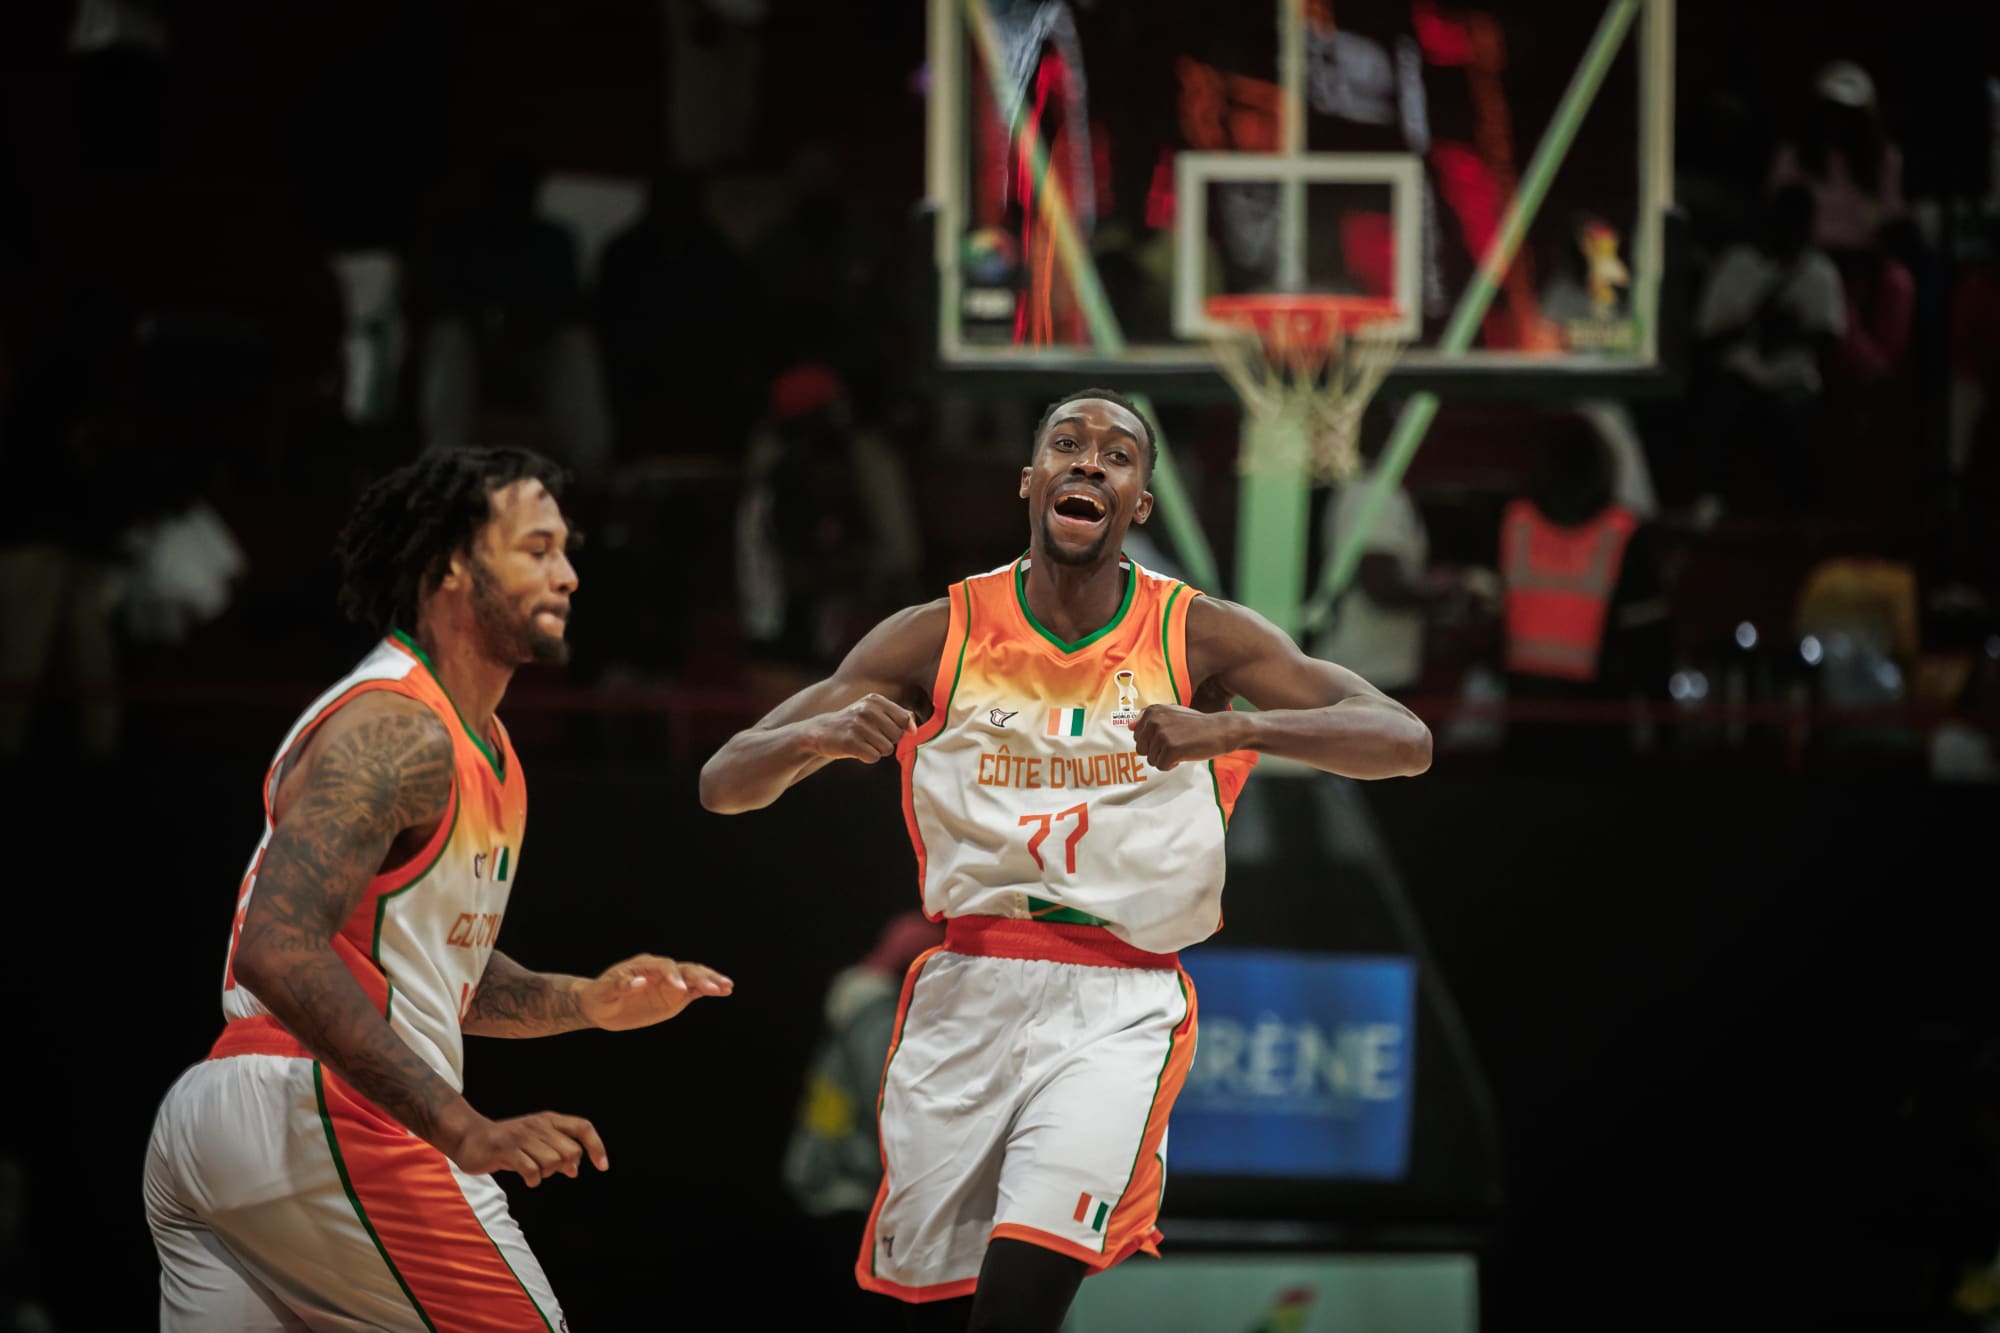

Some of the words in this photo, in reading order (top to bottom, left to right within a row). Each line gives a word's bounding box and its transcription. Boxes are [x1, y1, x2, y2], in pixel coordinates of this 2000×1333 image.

[978, 744, 1042, 789] CÔTE
[1050, 752, 1148, 789] D'IVOIRE
[1018, 802, 1089, 874] 77
